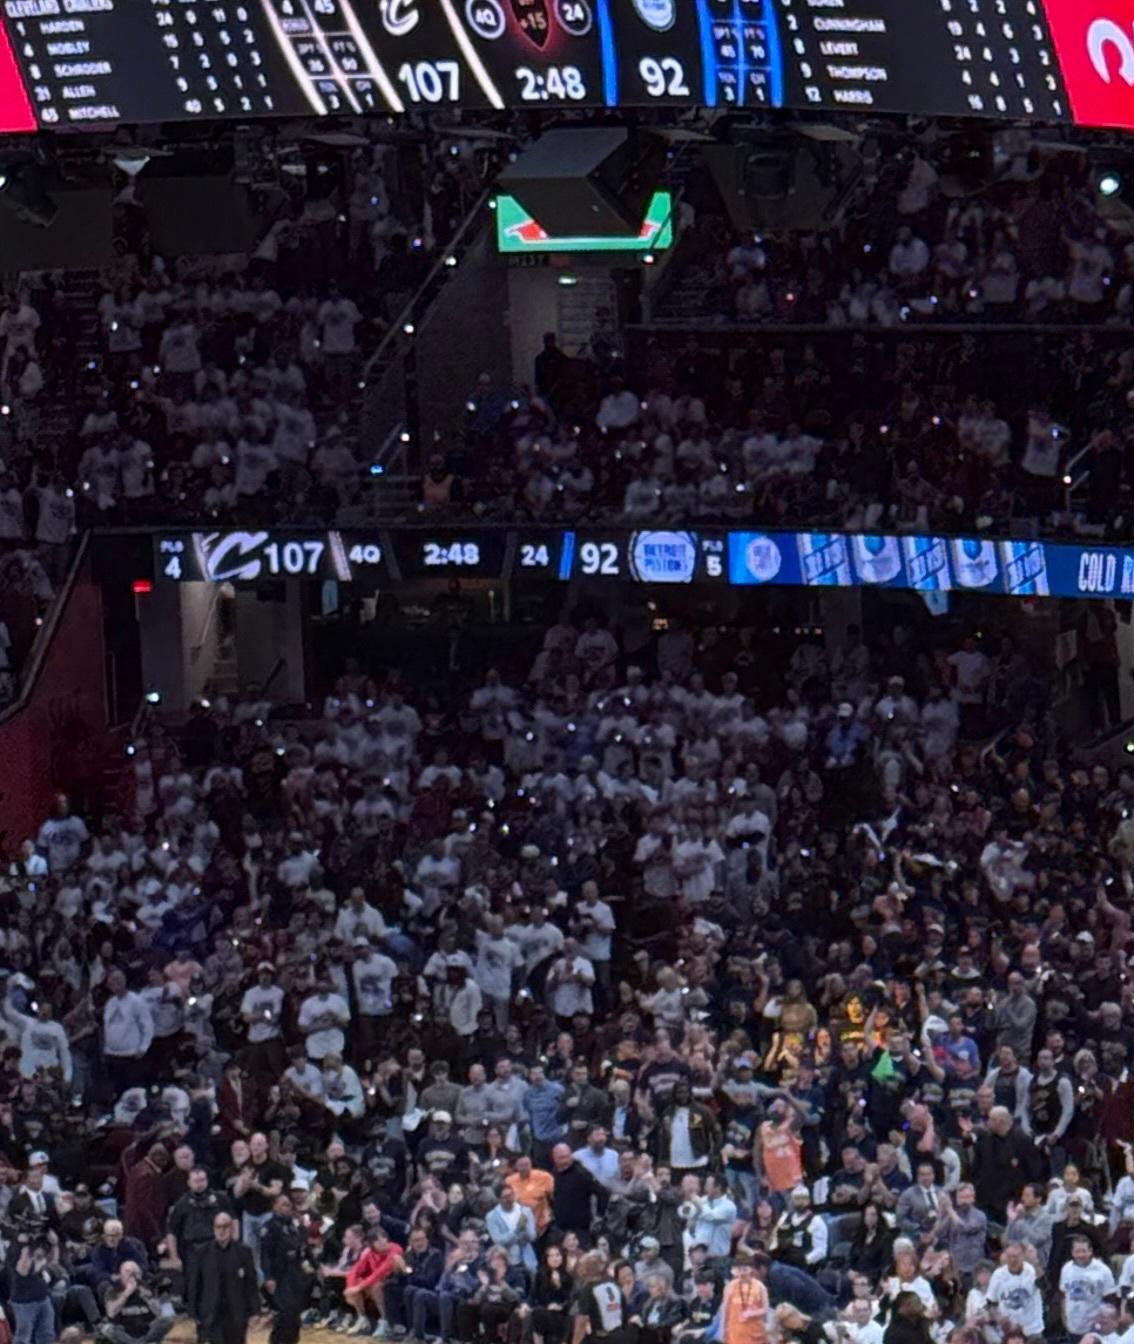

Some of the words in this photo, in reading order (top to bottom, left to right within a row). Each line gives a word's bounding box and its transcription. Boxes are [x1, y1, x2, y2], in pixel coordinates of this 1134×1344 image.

[563, 3, 584, 22] 24
[399, 62, 459, 103] 107
[515, 66, 586, 101] 2:48
[639, 57, 690, 97] 92
[264, 542, 324, 573] 107
[349, 546, 381, 564] 4Q
[423, 544, 479, 565] 2:48
[521, 546, 549, 566] 24
[581, 543, 620, 574] 92
[643, 544, 687, 556] DETROIT
[165, 557, 181, 579] 4
[644, 558, 688, 572] PISTONS
[706, 555, 722, 576] 5
[1077, 552, 1117, 592] COLD
